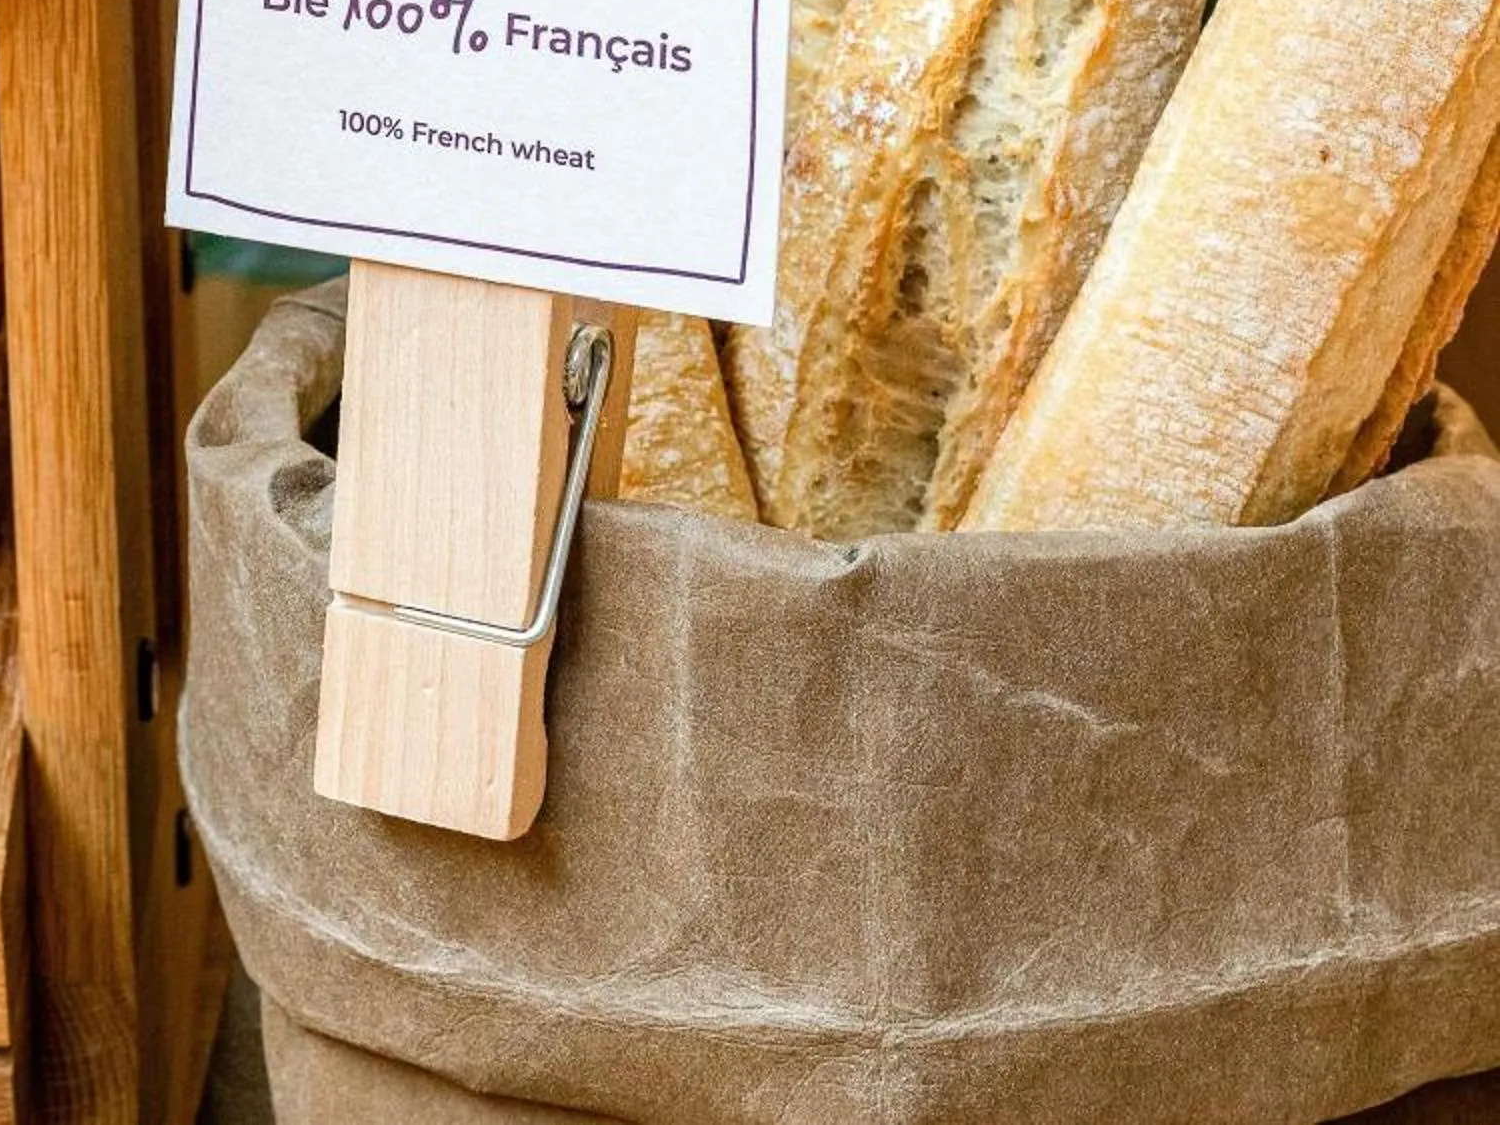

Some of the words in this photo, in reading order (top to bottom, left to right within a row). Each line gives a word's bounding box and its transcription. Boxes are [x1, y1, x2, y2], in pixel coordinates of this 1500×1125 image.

[504, 11, 693, 75] Français
[338, 108, 404, 141] 100%
[411, 120, 504, 157] French
[510, 139, 596, 172] wheat
